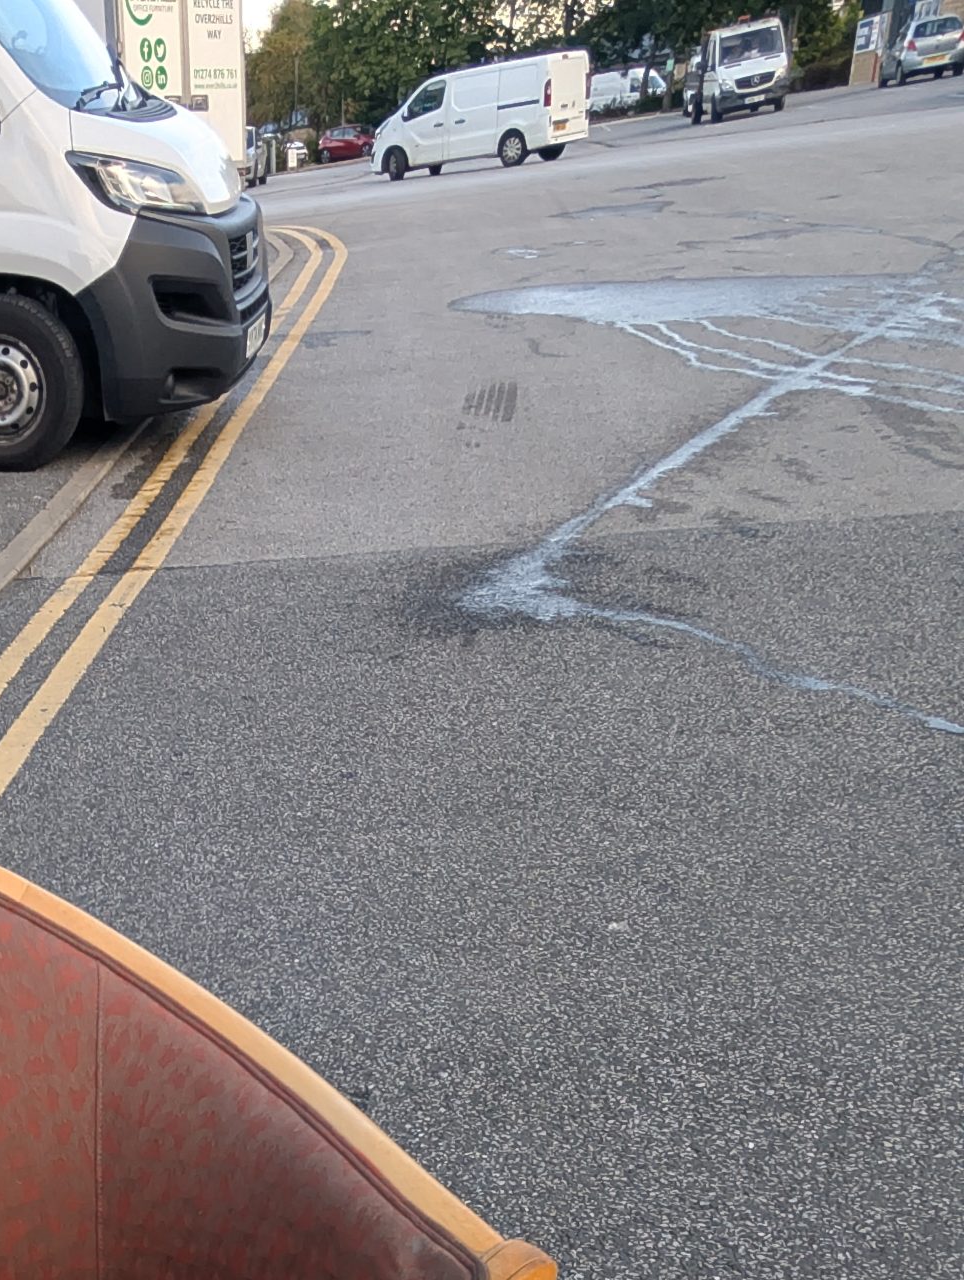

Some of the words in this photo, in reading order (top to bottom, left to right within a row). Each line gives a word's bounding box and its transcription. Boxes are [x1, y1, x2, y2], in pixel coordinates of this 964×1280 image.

[133, 4, 148, 12] OFFICE
[193, 0, 219, 8] RECYCLE
[222, 0, 233, 9] THE
[195, 14, 233, 24] OVER2HILLS
[207, 30, 221, 39] WAY
[194, 69, 211, 79] 01274
[213, 69, 225, 79] 876
[227, 69, 237, 79] 761
